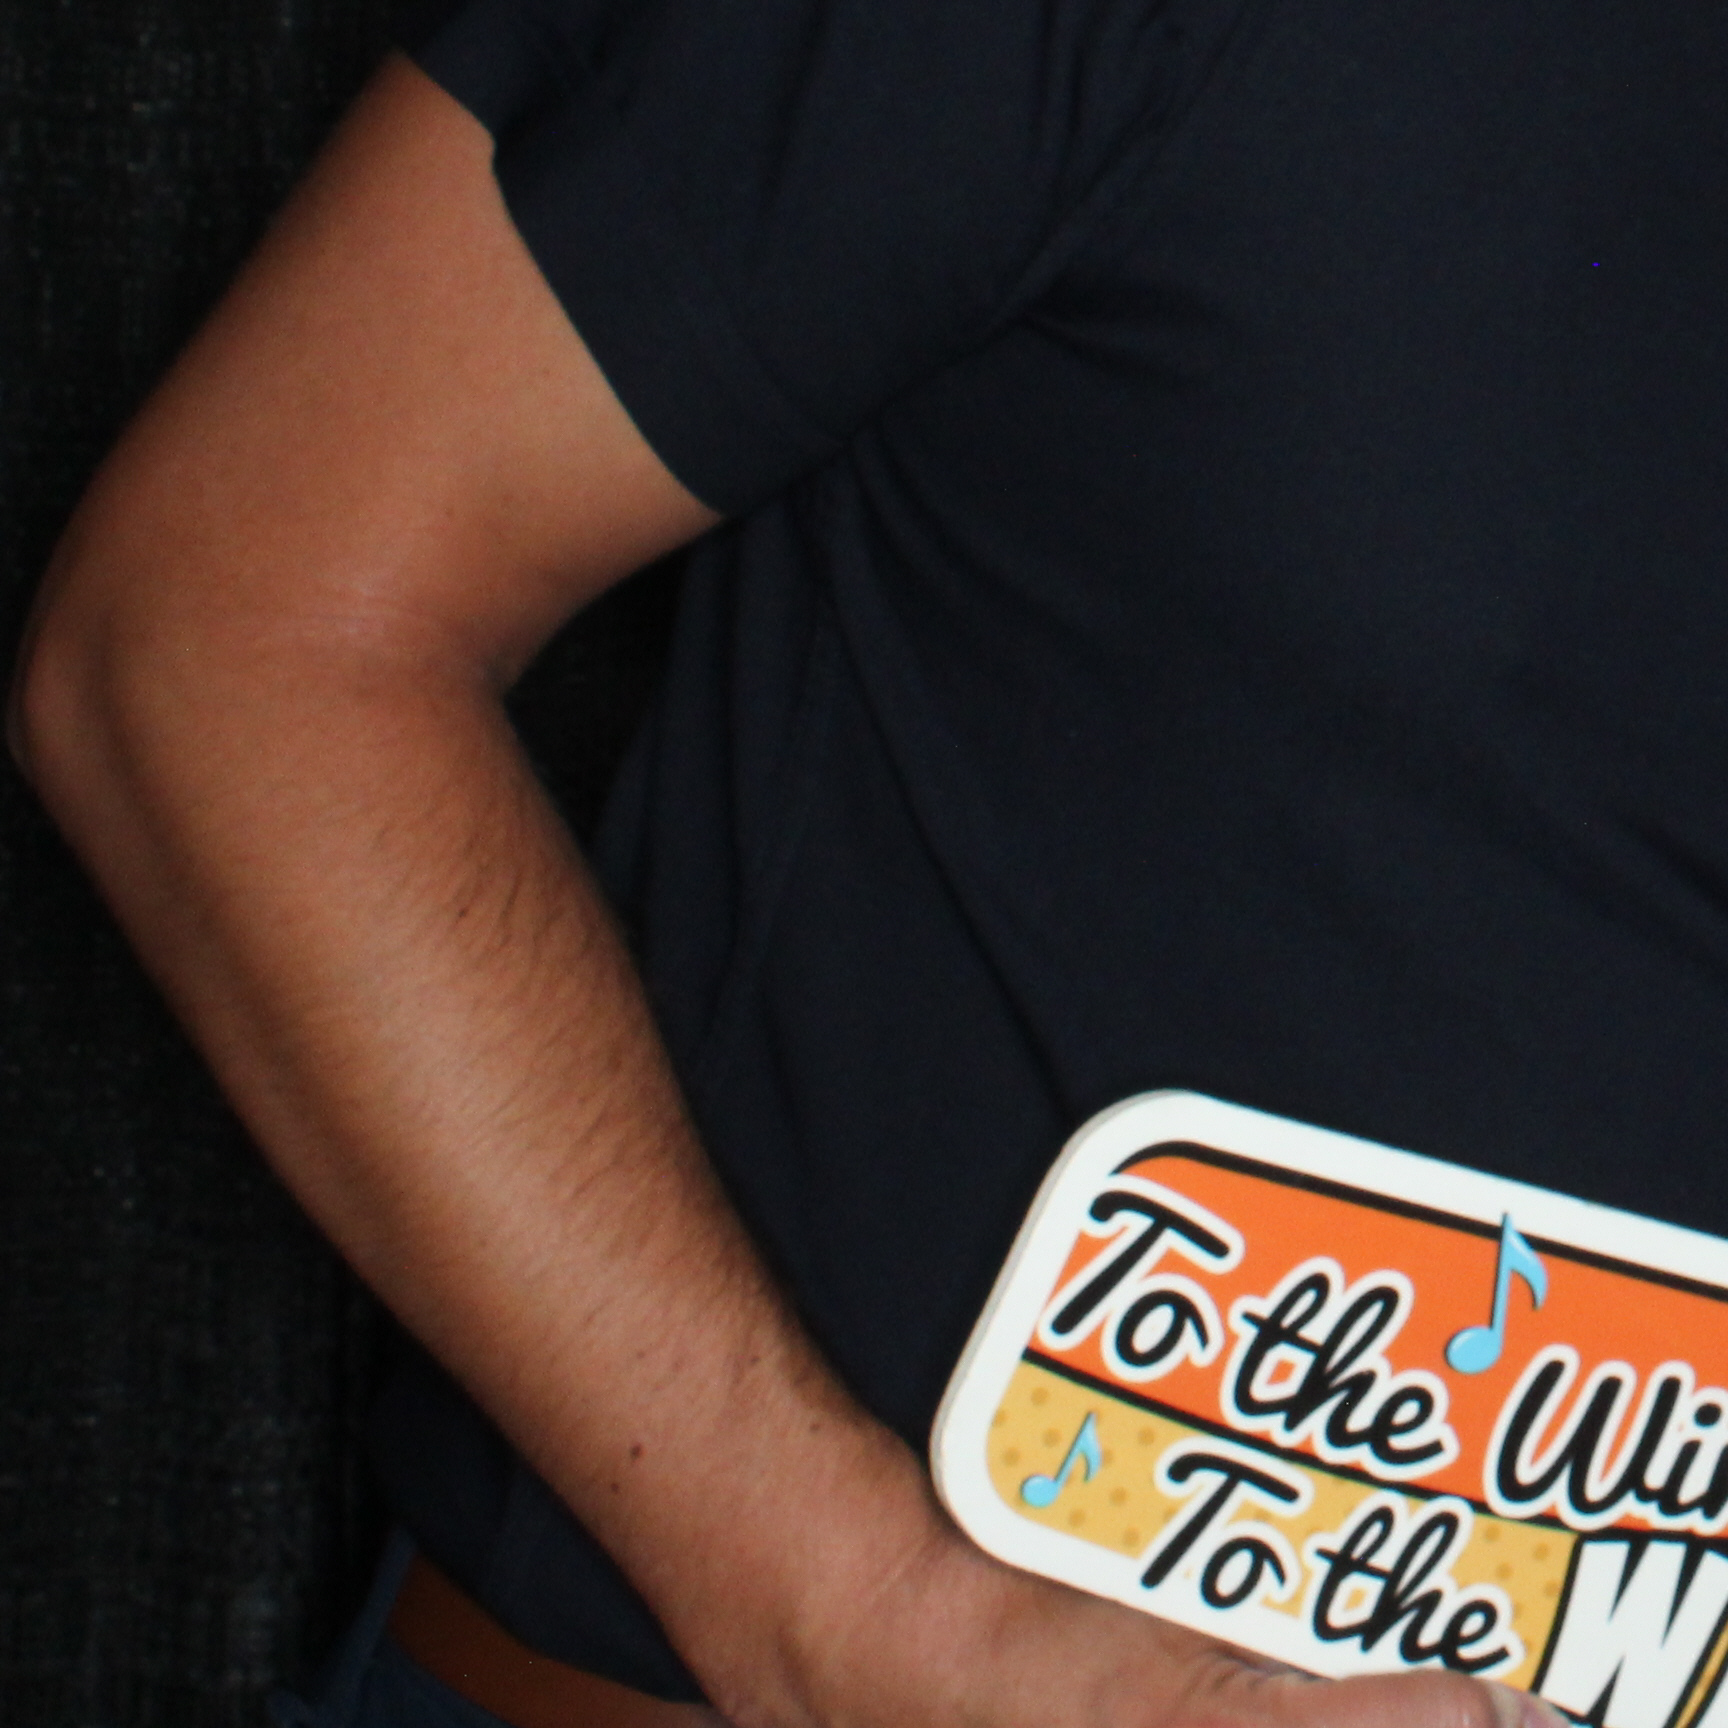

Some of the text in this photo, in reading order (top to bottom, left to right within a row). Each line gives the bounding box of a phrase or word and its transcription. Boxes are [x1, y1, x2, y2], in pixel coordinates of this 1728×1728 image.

[1049, 1189, 1231, 1369] To
[1240, 1270, 1446, 1466] the
[1139, 1451, 1301, 1610] To
[1313, 1505, 1510, 1673] the
